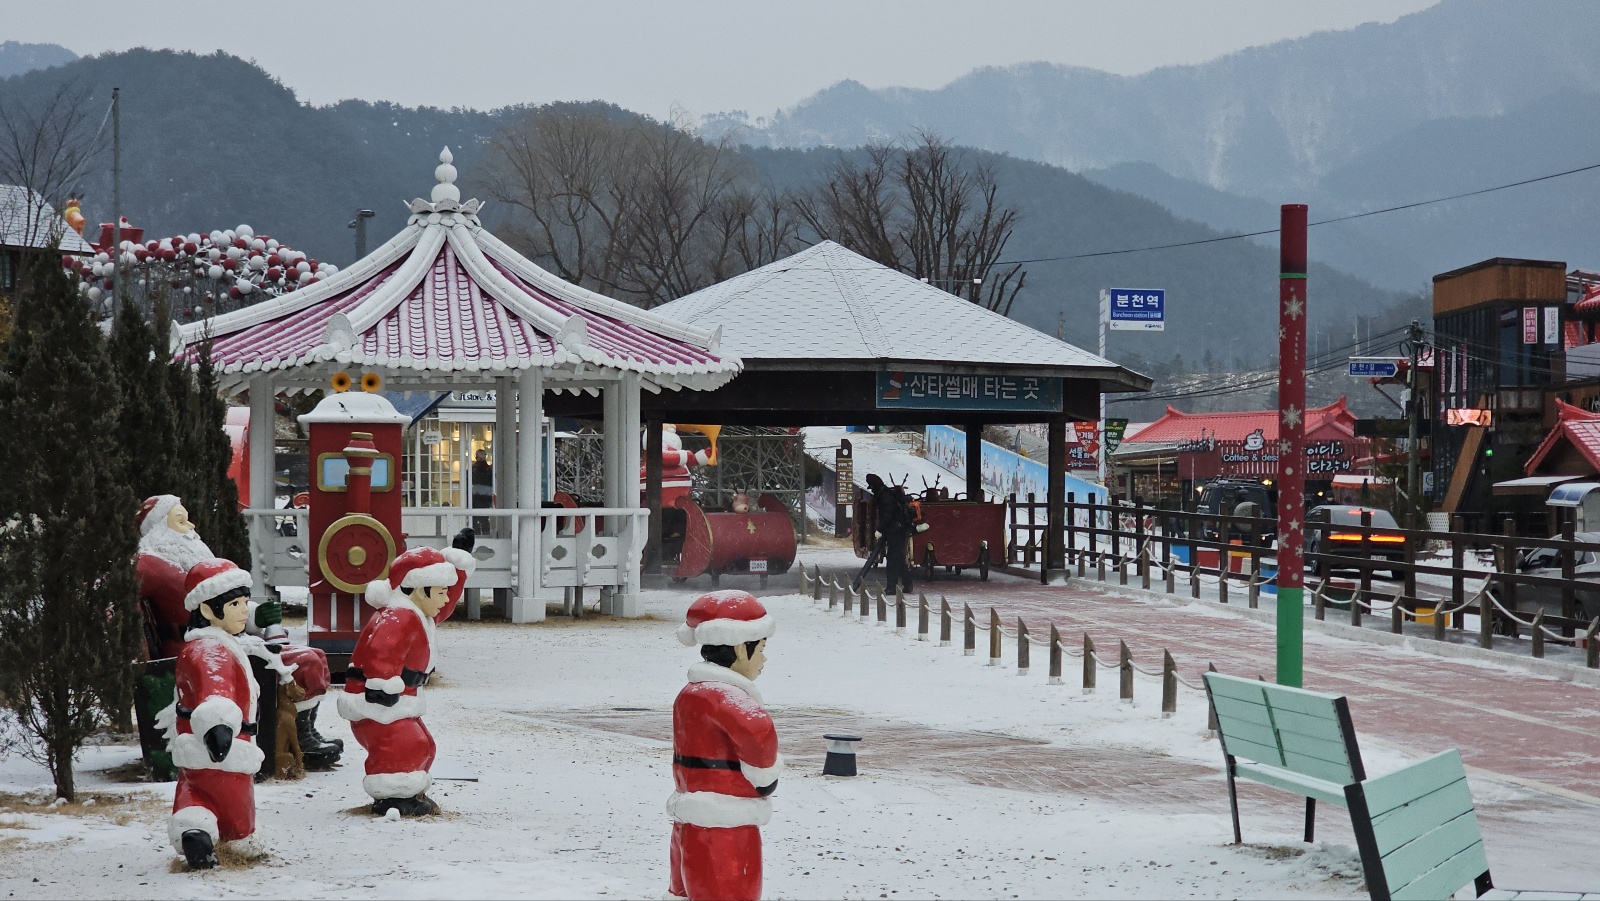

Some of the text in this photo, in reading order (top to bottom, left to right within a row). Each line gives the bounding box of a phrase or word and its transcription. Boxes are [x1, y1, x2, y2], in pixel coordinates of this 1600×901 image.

[1117, 295, 1158, 308] 분천역
[910, 375, 1039, 400] 산타썰매 타는 곳
[1223, 453, 1249, 462] Coffee
